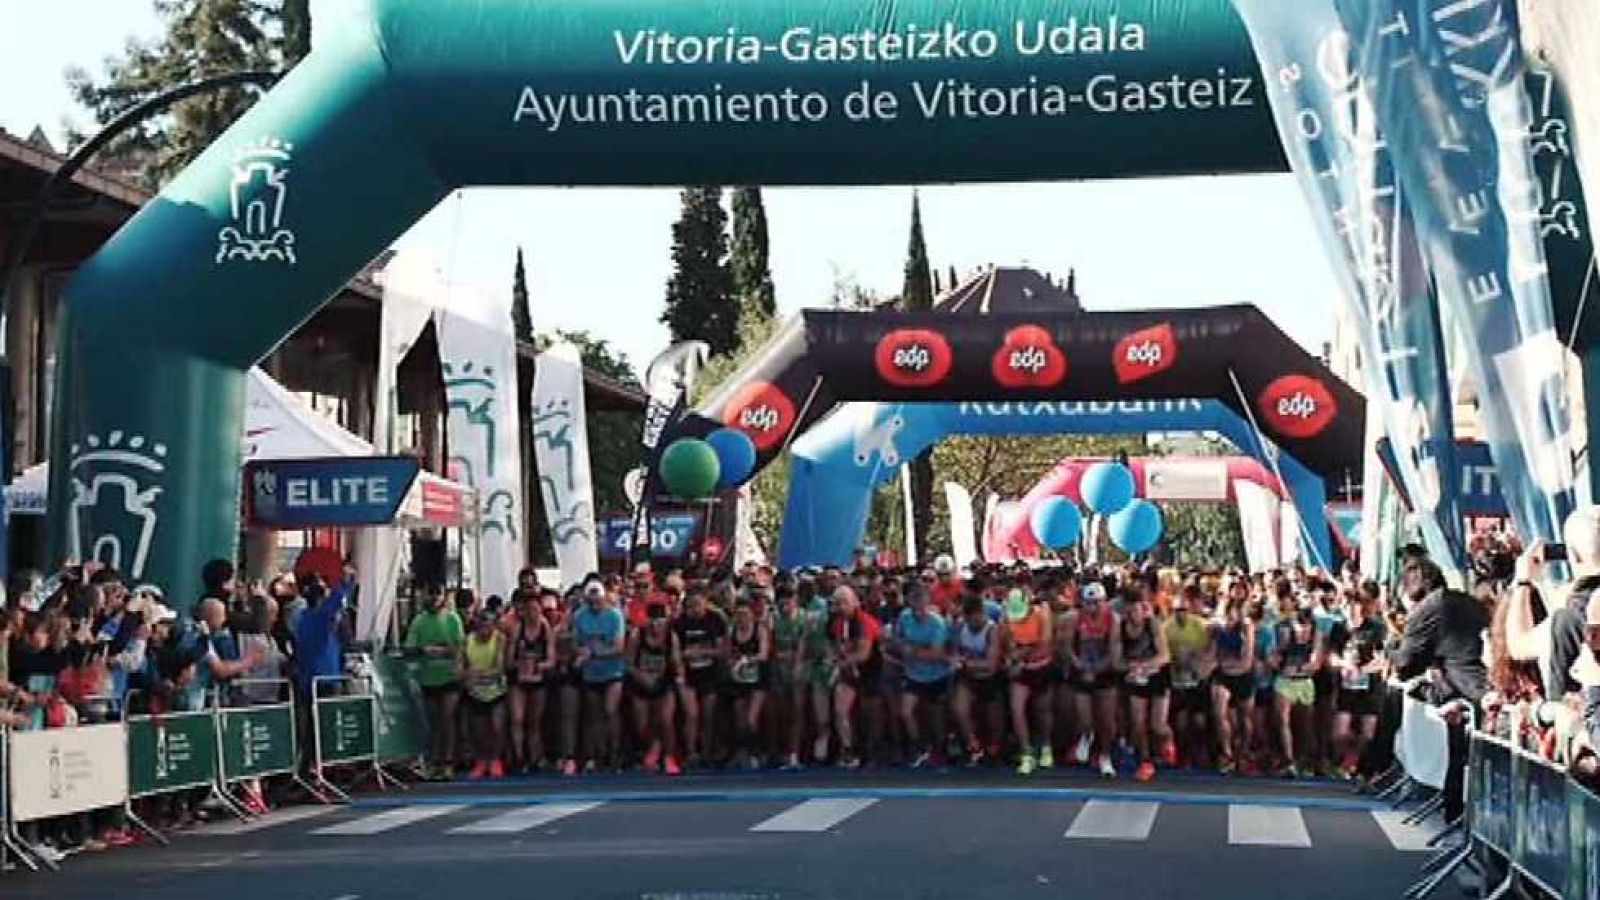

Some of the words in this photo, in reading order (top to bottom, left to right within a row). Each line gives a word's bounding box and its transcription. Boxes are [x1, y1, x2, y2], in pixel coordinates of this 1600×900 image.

[613, 23, 999, 65] Vitoria-Gasteizko
[1015, 17, 1145, 56] Udala
[513, 83, 828, 131] Ayuntamiento
[843, 79, 898, 120] de
[912, 70, 1253, 118] Vitoria-Gasteiz
[286, 476, 389, 507] ELITE
